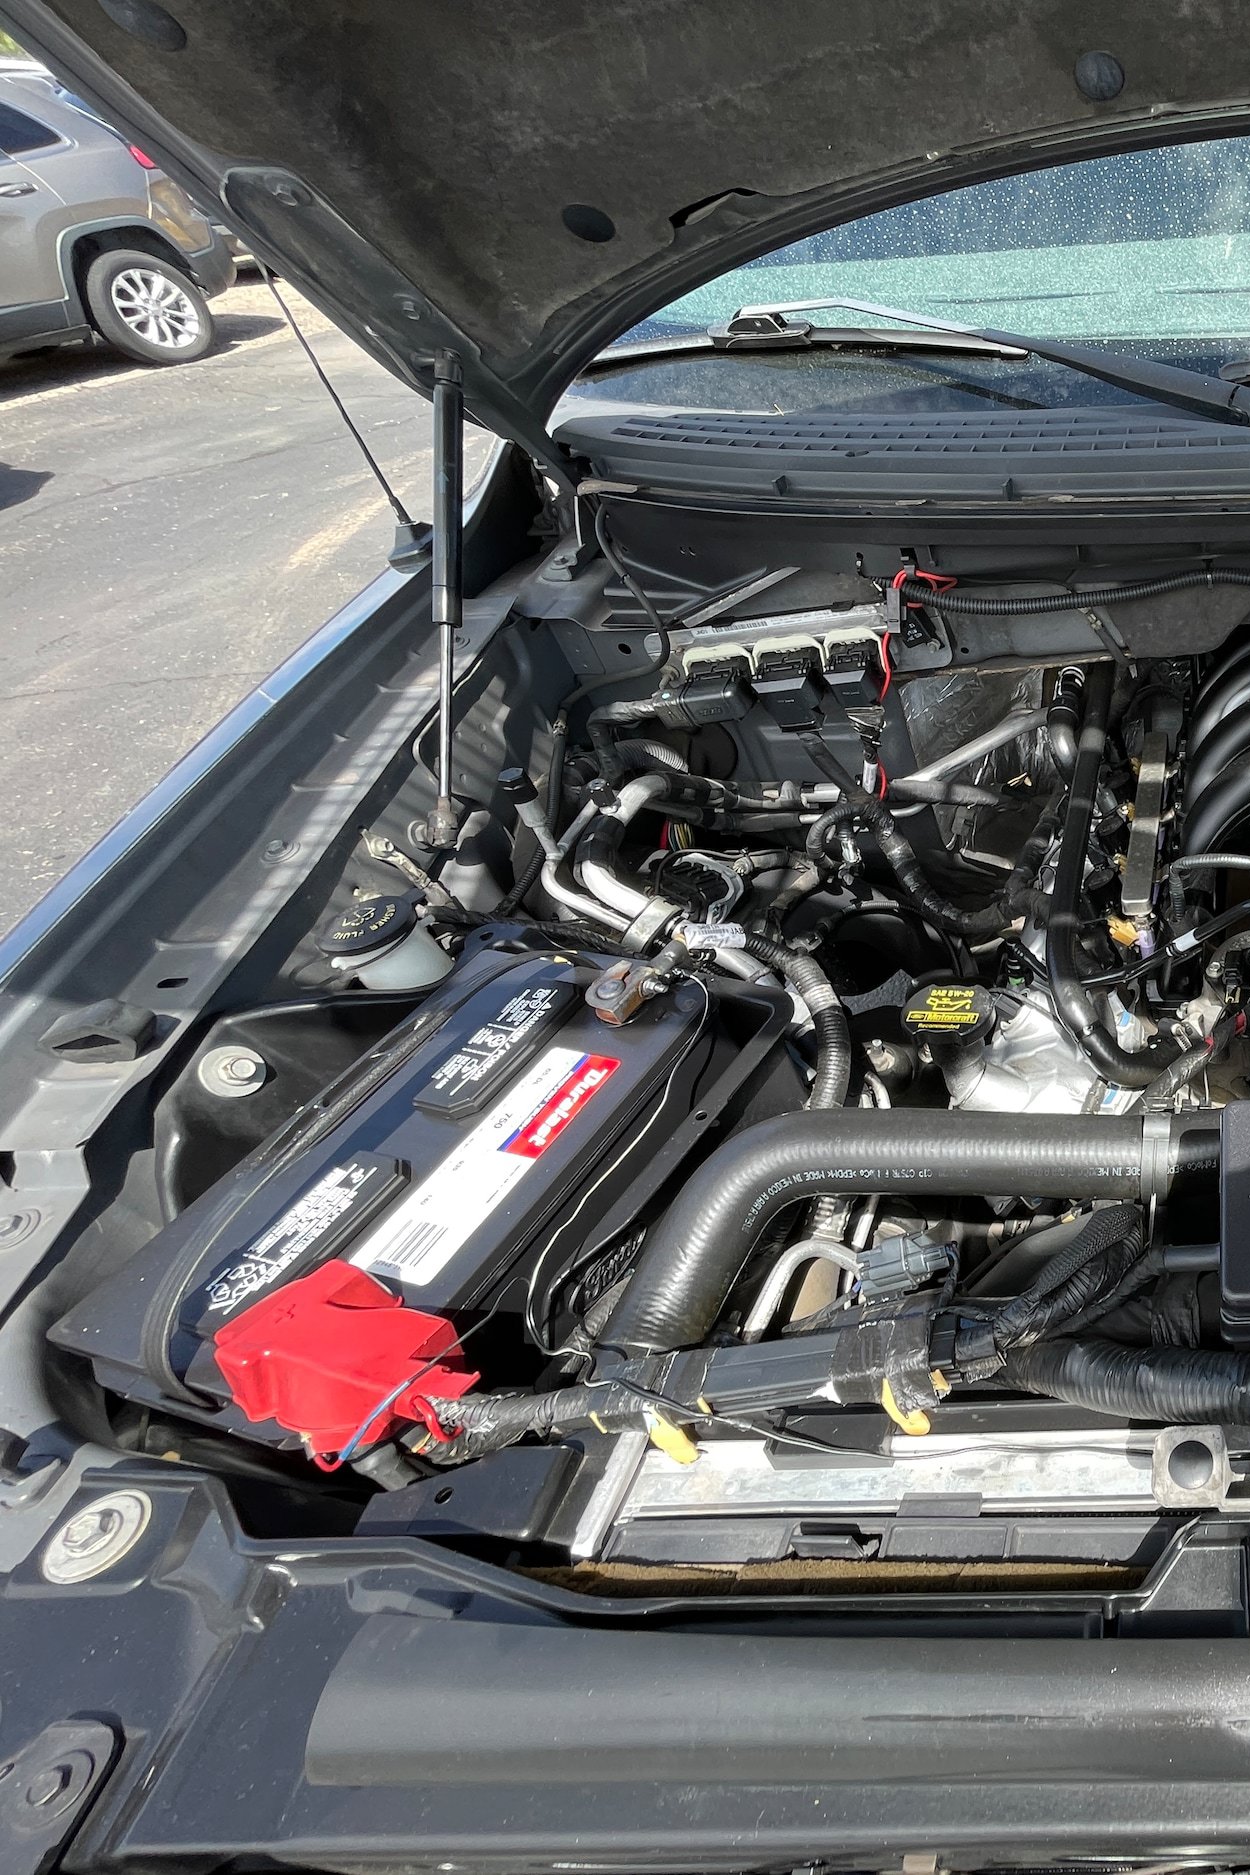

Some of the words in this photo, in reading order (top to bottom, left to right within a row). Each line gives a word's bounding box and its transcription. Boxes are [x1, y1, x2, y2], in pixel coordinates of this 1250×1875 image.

[368, 904, 396, 931] WASHER
[332, 929, 365, 940] FLUID
[931, 989, 946, 997] SAE
[947, 989, 974, 997] 5W-20
[927, 1013, 974, 1022] Motorcraft
[509, 1010, 546, 1043] DANGER
[470, 1049, 507, 1081] POISON
[528, 1069, 609, 1147] Duralast
[803, 1170, 825, 1181] MADE
[1111, 1166, 1122, 1177] IN
[767, 1177, 792, 1195] MEXICO
